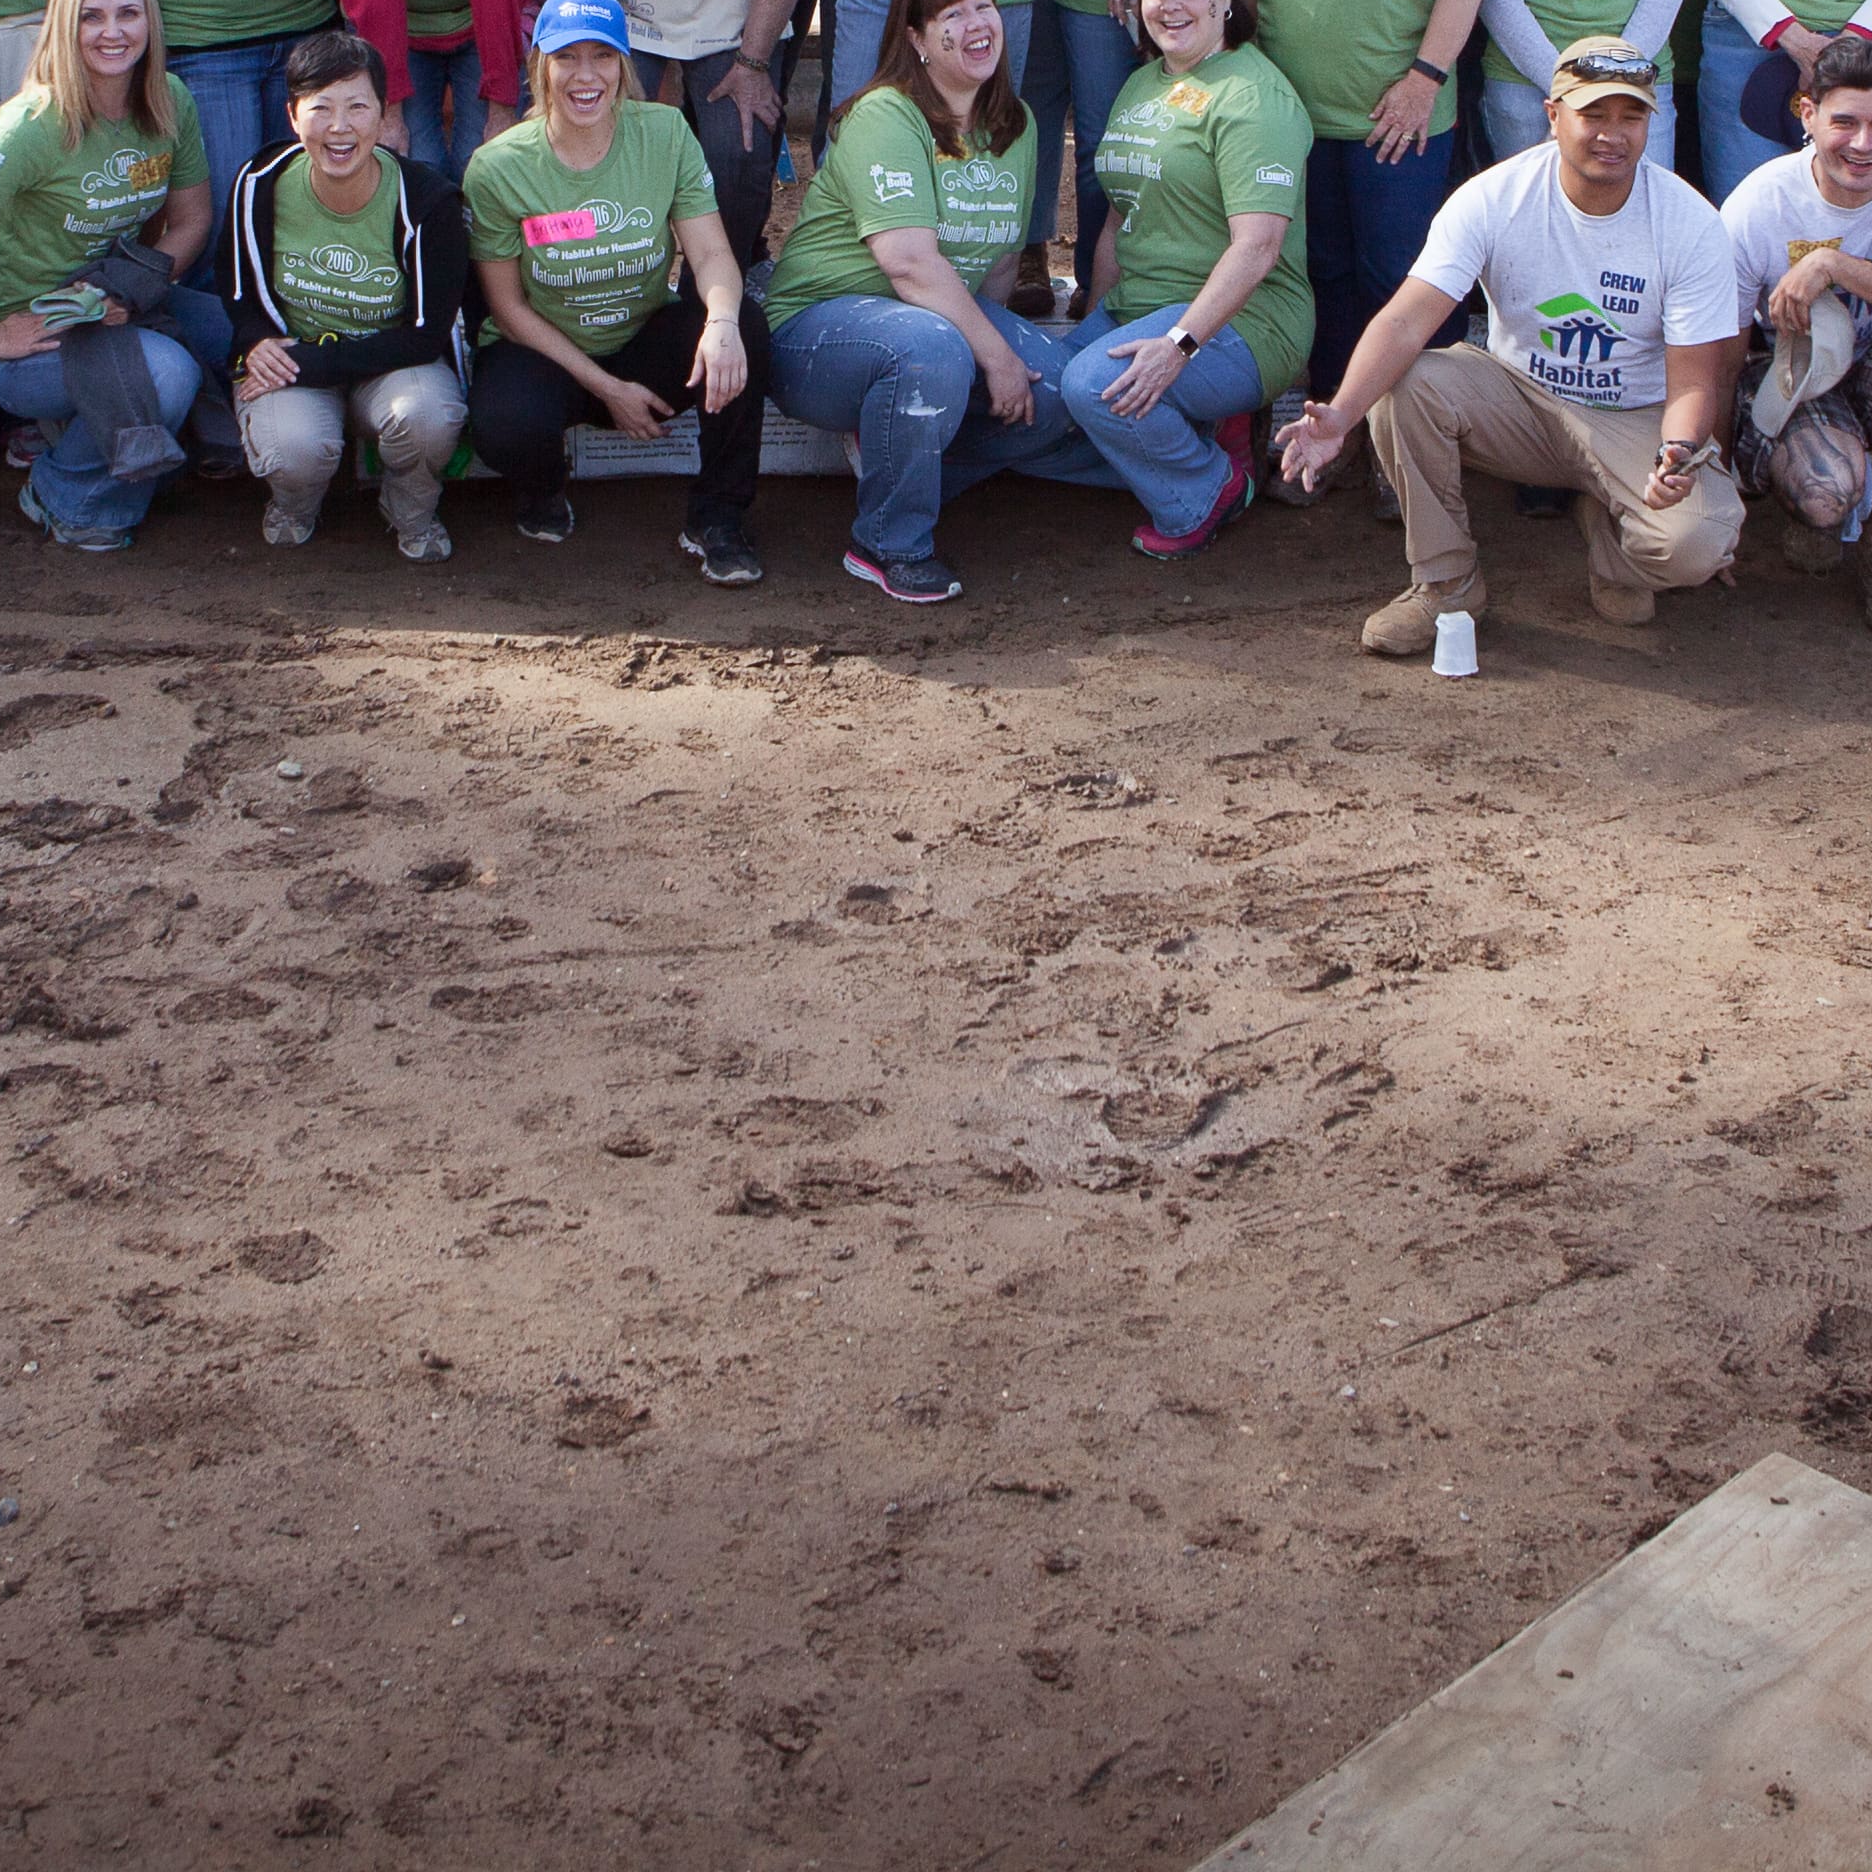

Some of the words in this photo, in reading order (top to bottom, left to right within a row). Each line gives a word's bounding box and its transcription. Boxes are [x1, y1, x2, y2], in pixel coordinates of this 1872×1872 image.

[581, 3, 611, 16] Habitat
[64, 212, 108, 232] National
[326, 251, 354, 271] 2016
[562, 246, 597, 260] Habitat
[599, 245, 611, 257] for
[532, 261, 572, 288] National
[575, 266, 616, 286] Women
[617, 260, 647, 281] Build
[1600, 271, 1646, 294] CREW
[1603, 295, 1639, 315] LEAD
[1529, 353, 1622, 388] Habitat
